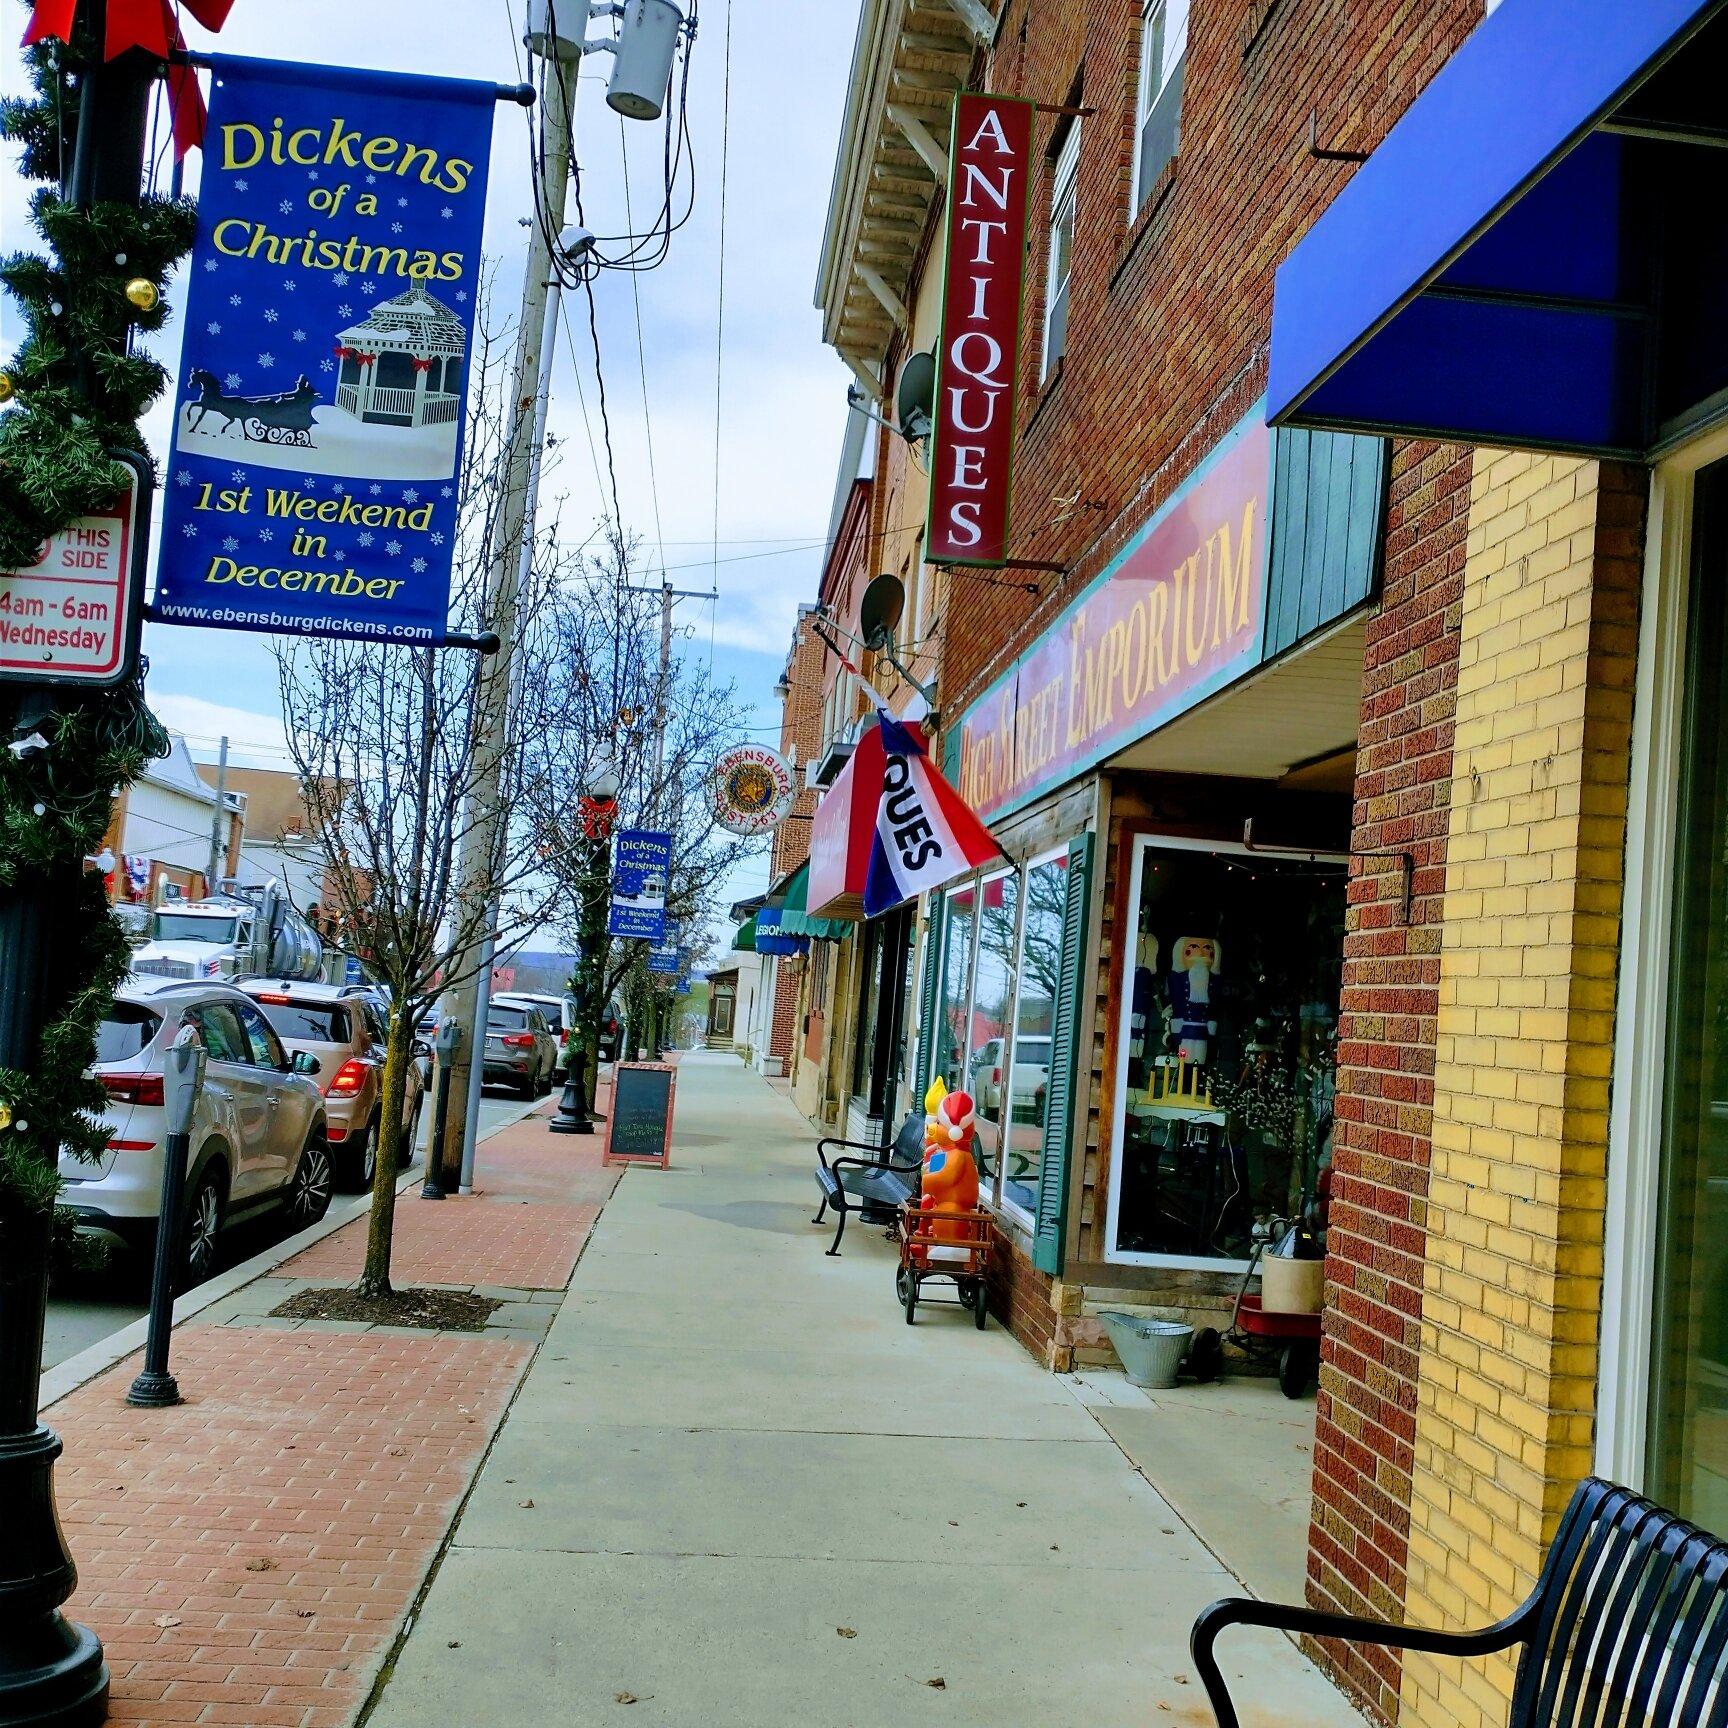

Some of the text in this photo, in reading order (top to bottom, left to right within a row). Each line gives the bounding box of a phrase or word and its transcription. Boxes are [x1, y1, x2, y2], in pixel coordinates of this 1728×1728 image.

[221, 117, 474, 194] Dickens
[308, 184, 378, 218] of a
[212, 219, 464, 281] Christmas
[947, 109, 1015, 547] ANTIQUES
[193, 483, 434, 531] 1st Weekend
[64, 528, 110, 548] THIS
[292, 527, 327, 558] in
[61, 550, 108, 569] SIDE
[205, 556, 405, 600] December
[0, 591, 43, 617] 4am
[62, 596, 108, 621] 6am
[161, 604, 433, 639] www.ebensburgdickens.com
[1065, 496, 1256, 749] EMPORIUM
[621, 840, 668, 855] Dickens
[620, 860, 666, 871] Christmas
